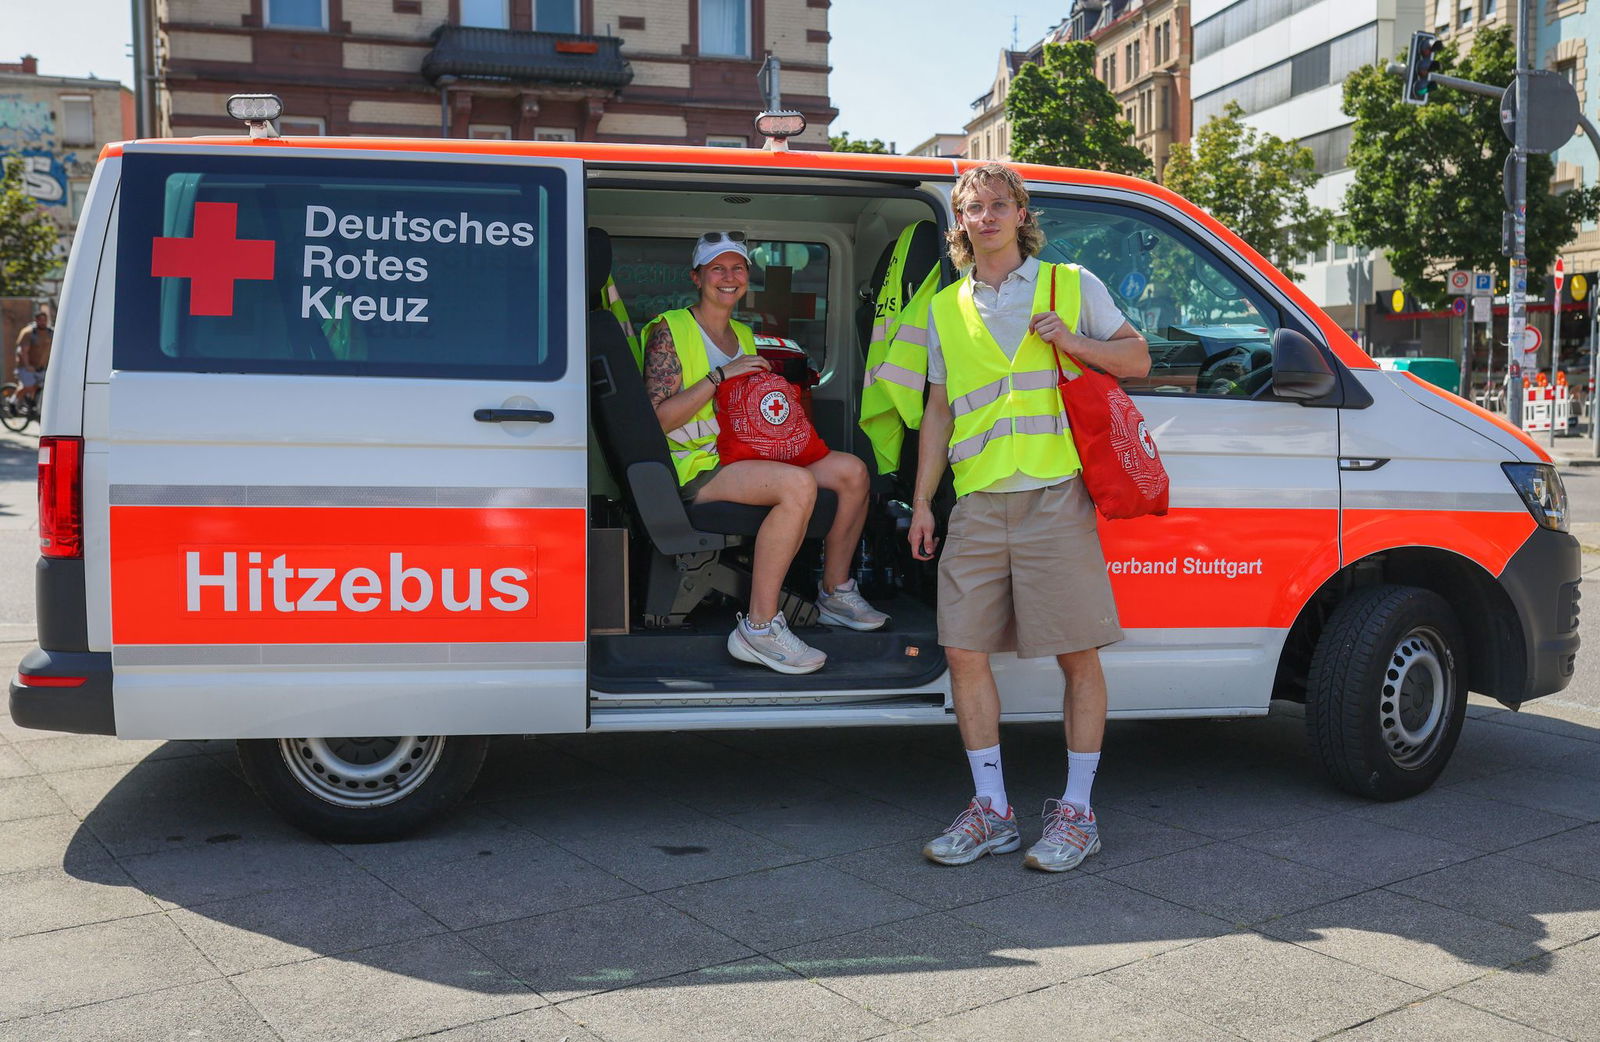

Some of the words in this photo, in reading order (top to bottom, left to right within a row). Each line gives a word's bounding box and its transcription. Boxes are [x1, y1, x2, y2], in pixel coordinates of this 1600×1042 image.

[305, 205, 535, 248] Deutsches
[303, 245, 429, 283] Rotes
[301, 285, 430, 324] Kreuz
[1123, 449, 1132, 469] DRK
[186, 551, 531, 614] Hitzebus
[1183, 557, 1263, 579] Stuttgart
